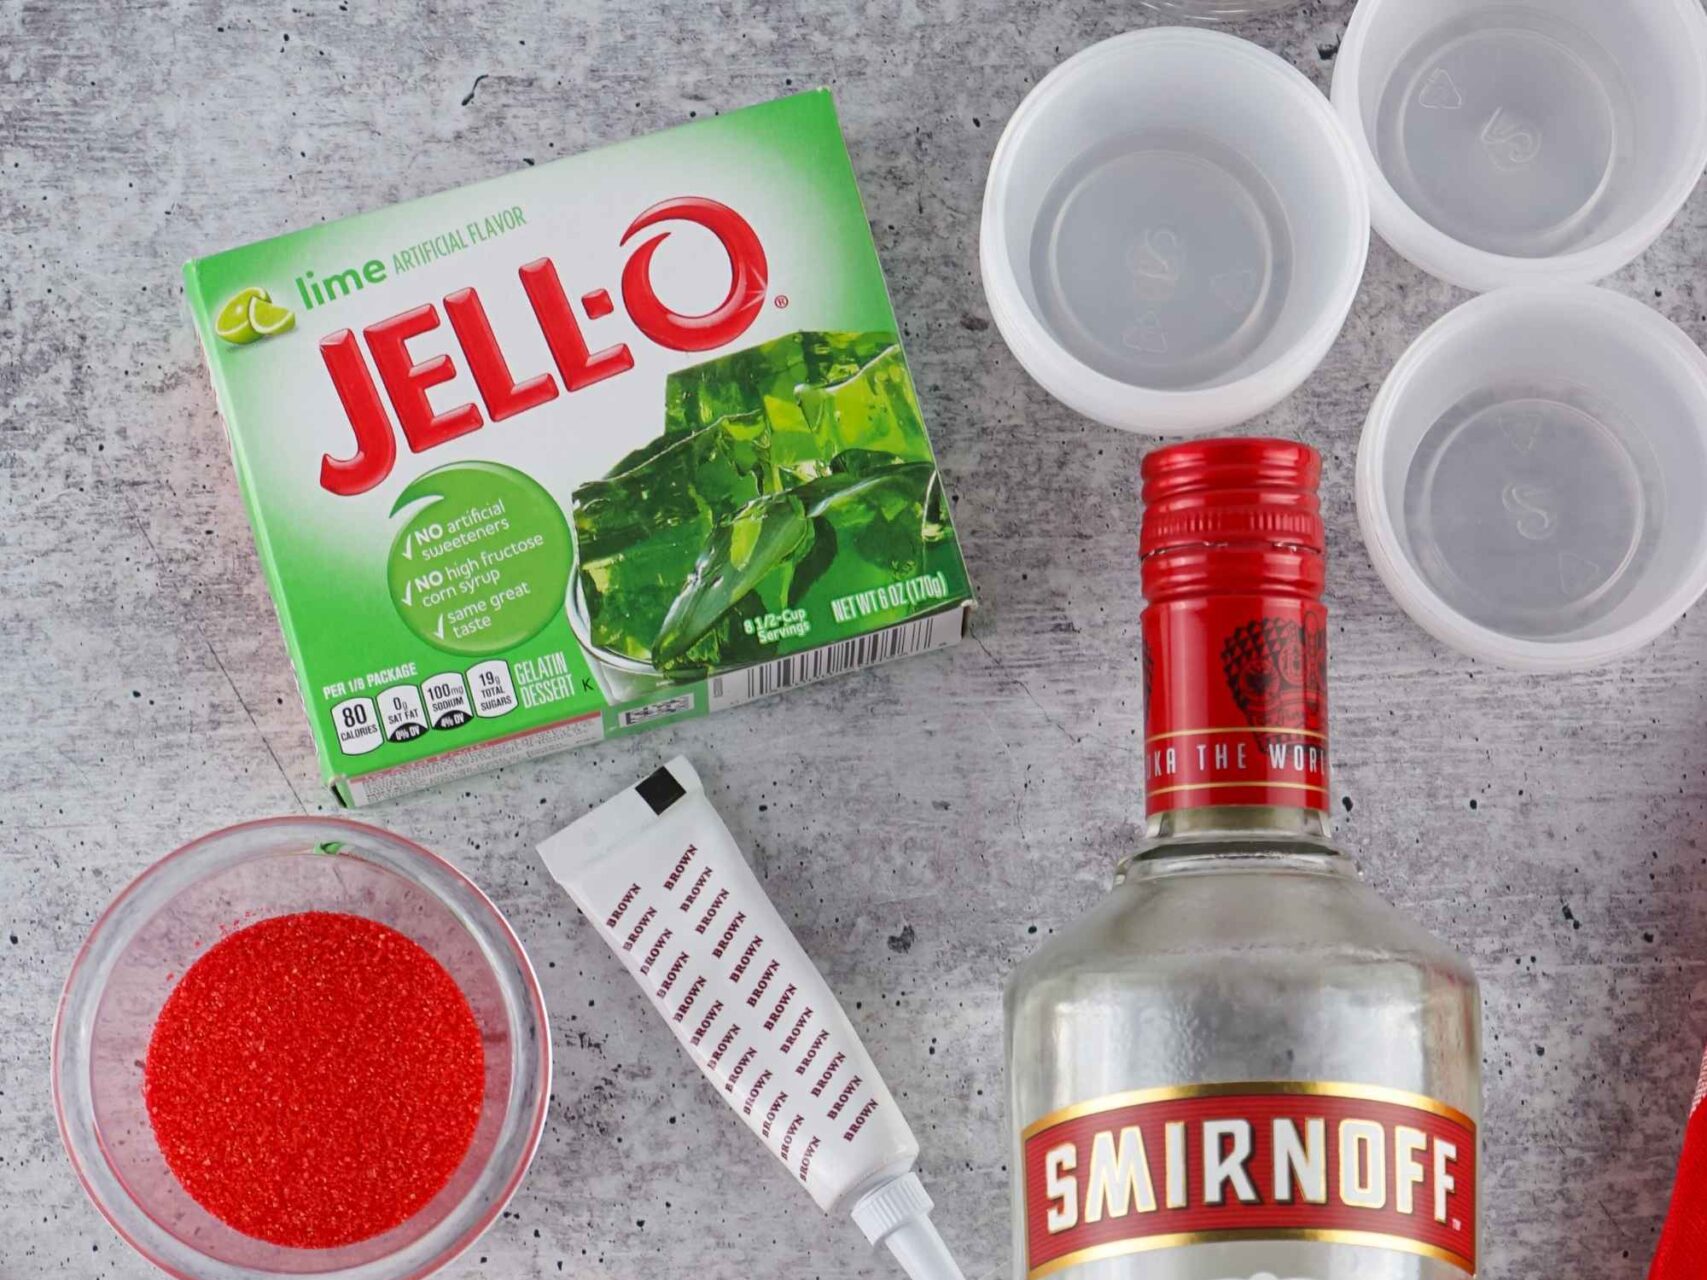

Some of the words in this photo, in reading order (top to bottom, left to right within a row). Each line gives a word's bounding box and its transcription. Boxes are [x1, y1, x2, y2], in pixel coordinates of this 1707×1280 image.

[296, 259, 387, 310] lime
[393, 229, 468, 274] ARTIFICIAL
[466, 206, 527, 246] FLAVOR
[415, 524, 443, 545] NO
[447, 499, 506, 533] artificial
[422, 518, 510, 560] sweeteners
[415, 571, 443, 592] NO
[445, 558, 480, 581] high
[480, 534, 544, 567] fructose
[422, 587, 457, 607] corn
[459, 570, 500, 594] syrup
[448, 600, 487, 624] same
[491, 582, 531, 611] great
[831, 598, 856, 623] NET
[854, 592, 878, 617] WT
[878, 591, 889, 610] 6
[888, 582, 909, 609] OZ
[907, 571, 949, 605] (170g)
[453, 615, 492, 639] taste
[743, 620, 754, 635] 8
[754, 608, 807, 631] 1/2-Cup
[757, 620, 811, 645] Servings
[322, 682, 346, 700] PER
[348, 677, 366, 693] 1/8
[366, 662, 418, 687] PACKAGE
[514, 651, 568, 685] GELATIN
[581, 677, 594, 692] K
[432, 697, 464, 712] SODIUM
[480, 696, 512, 712] SUGARS
[481, 686, 505, 698] TOTAL
[520, 674, 576, 709] DESSERT
[340, 724, 378, 741] CALORIES
[342, 704, 368, 728] 80
[388, 713, 403, 725] SAT
[404, 709, 419, 721] FAT
[1147, 747, 1177, 779] KA
[1197, 743, 1247, 771] THE
[664, 844, 697, 891] BROWN
[680, 867, 713, 913] BROWN
[606, 884, 641, 929] BROWN
[695, 889, 729, 934] BROWN
[623, 907, 656, 952] BROWN
[712, 912, 746, 958] BROWN
[640, 929, 672, 976] BROWN
[729, 936, 763, 983] BROWN
[656, 952, 689, 999] BROWN
[747, 960, 780, 1007] BROWN
[673, 976, 706, 1023] BROWN
[763, 984, 796, 1031] BROWN
[689, 1001, 723, 1046] BROWN
[780, 1007, 813, 1054] BROWN
[706, 1025, 741, 1071] BROWN
[796, 1030, 829, 1075] BROWN
[810, 1052, 845, 1098] BROWN
[827, 1076, 862, 1121] BROWN
[843, 1098, 878, 1142] BROWN
[1046, 1117, 1457, 1233] SMIRNOFF
